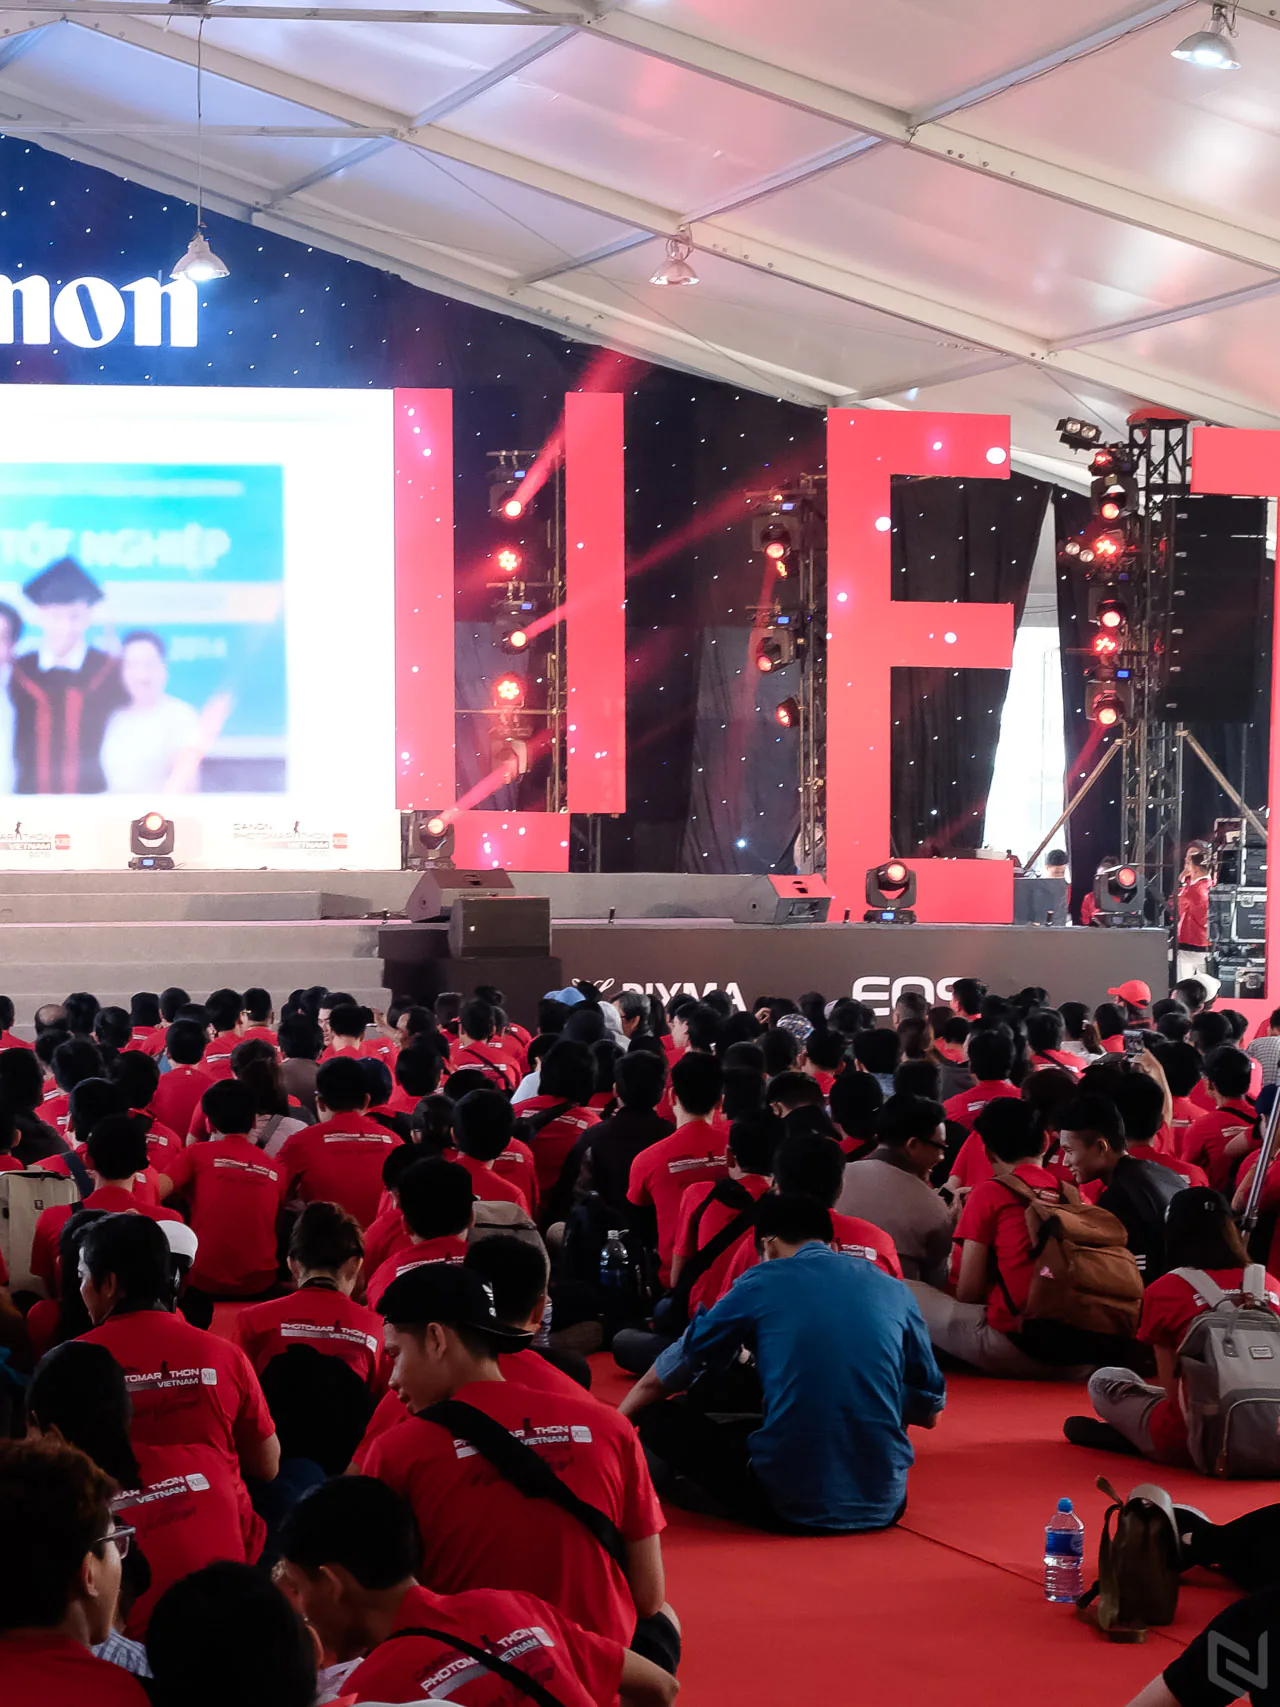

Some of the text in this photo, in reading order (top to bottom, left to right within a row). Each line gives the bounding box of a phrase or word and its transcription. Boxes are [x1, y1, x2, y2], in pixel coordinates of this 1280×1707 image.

[156, 1378, 199, 1388] VIETNAM
[534, 1425, 570, 1435] THON
[148, 1476, 185, 1491] THON
[136, 1485, 188, 1504] VIETNAM
[420, 1656, 479, 1691] PHOTOM
